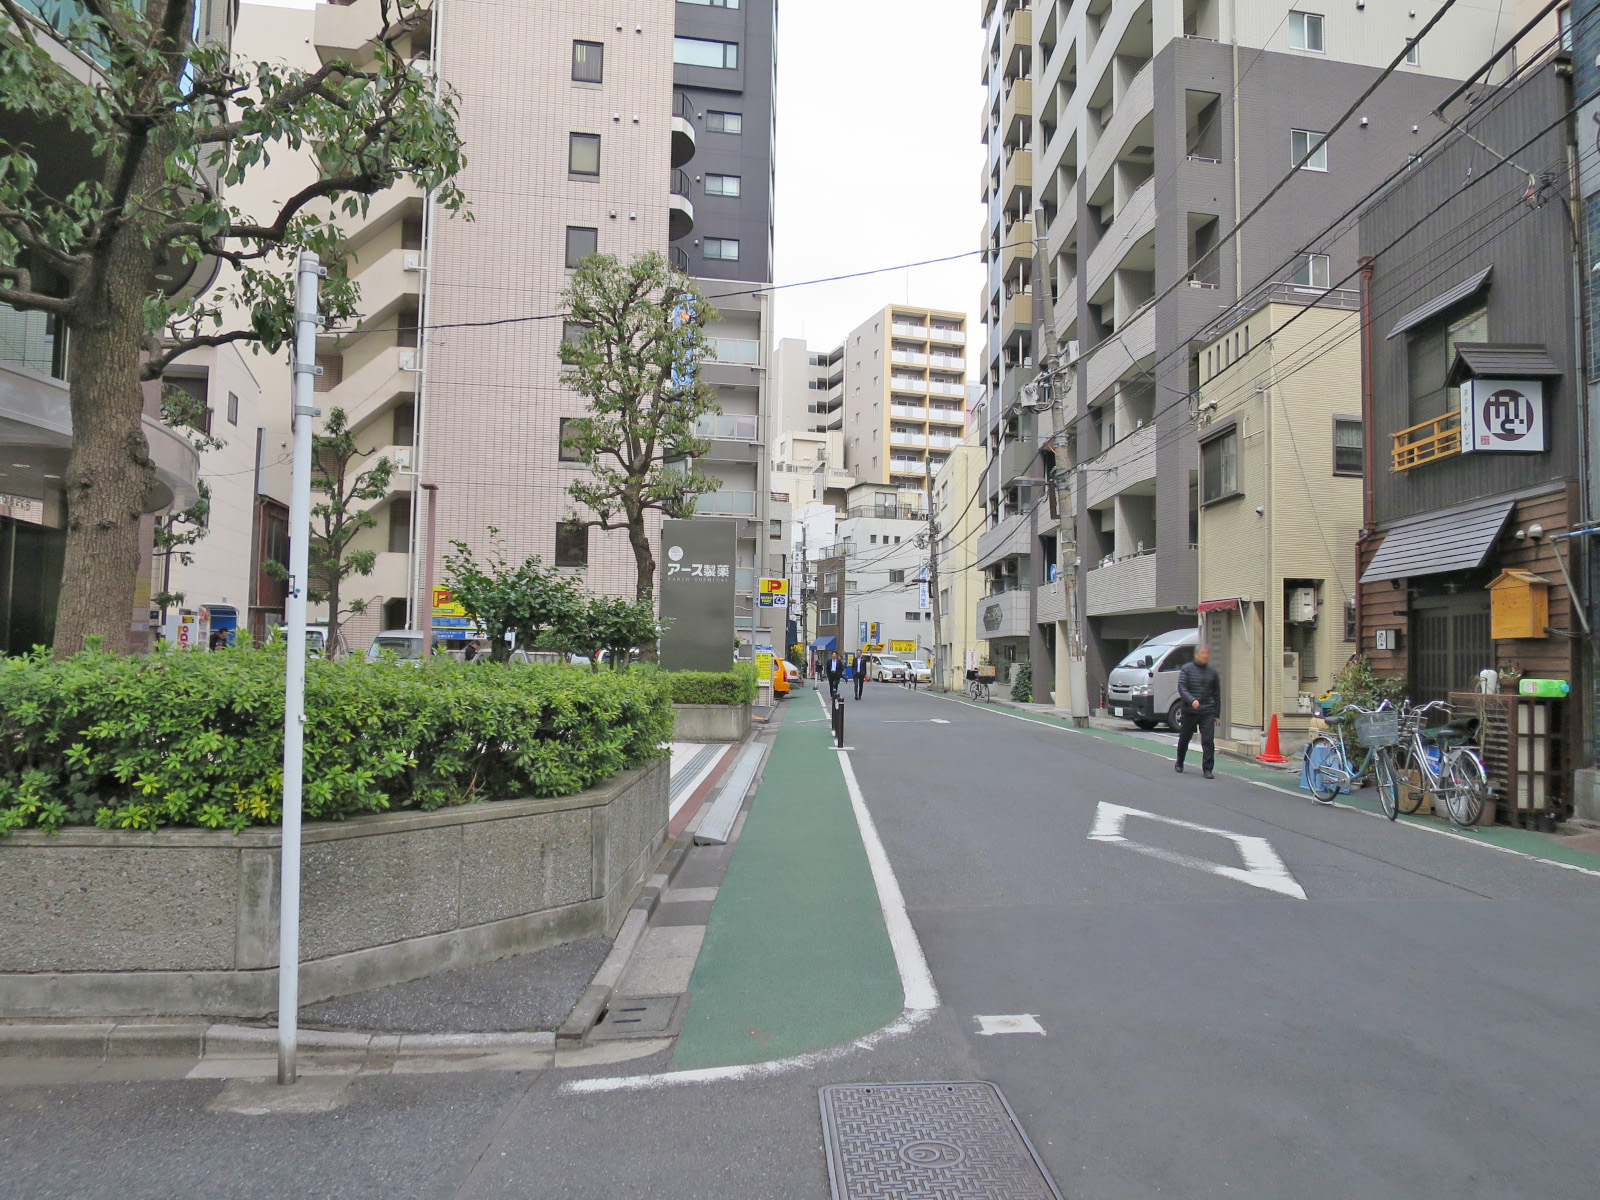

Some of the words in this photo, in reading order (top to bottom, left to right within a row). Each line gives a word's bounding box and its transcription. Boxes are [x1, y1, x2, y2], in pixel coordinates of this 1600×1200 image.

[667, 563, 730, 578] アース製薬
[768, 579, 782, 593] P
